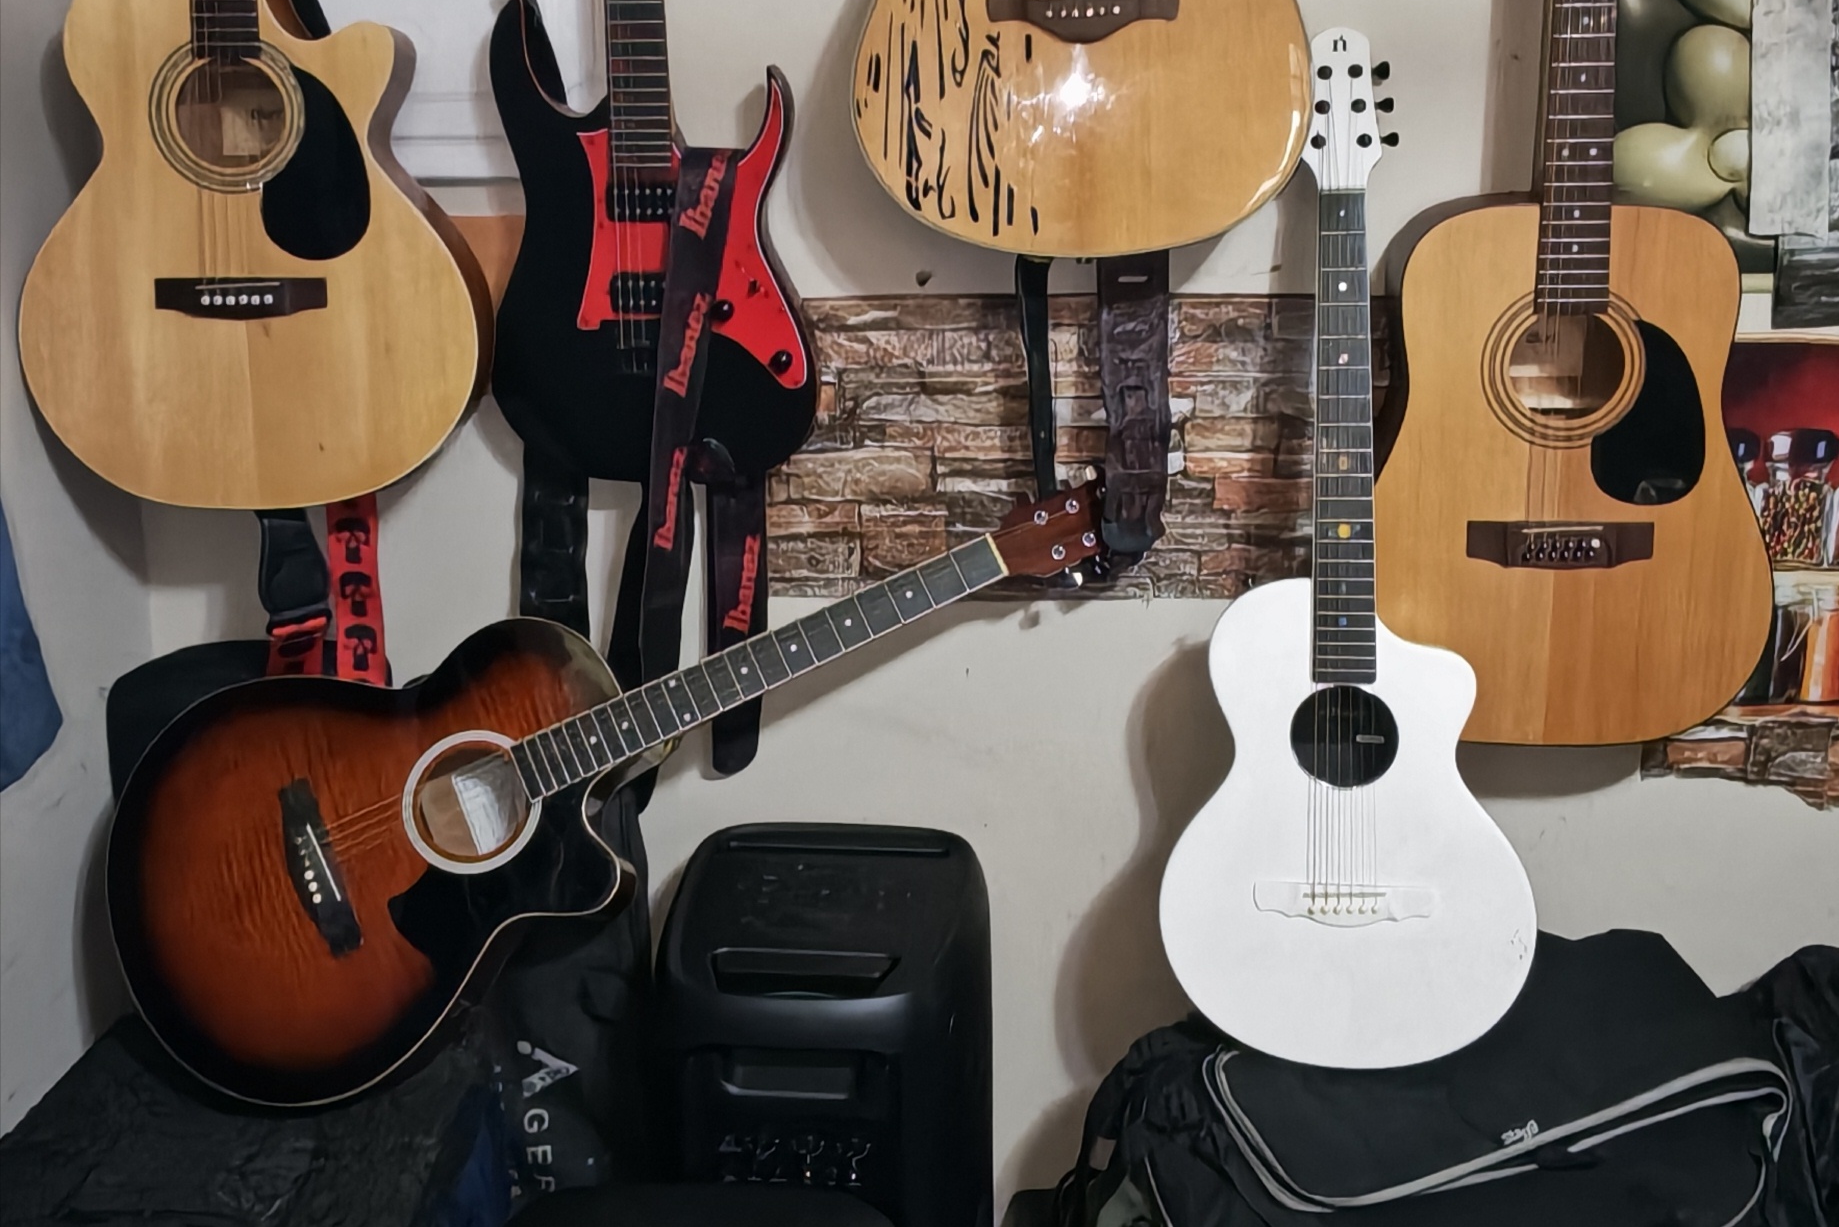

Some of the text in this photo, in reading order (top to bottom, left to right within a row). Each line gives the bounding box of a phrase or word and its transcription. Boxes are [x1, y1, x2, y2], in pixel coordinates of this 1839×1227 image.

[663, 292, 711, 398] Ibanez
[653, 446, 688, 552] Ibanez
[722, 533, 761, 635] Ibanez
